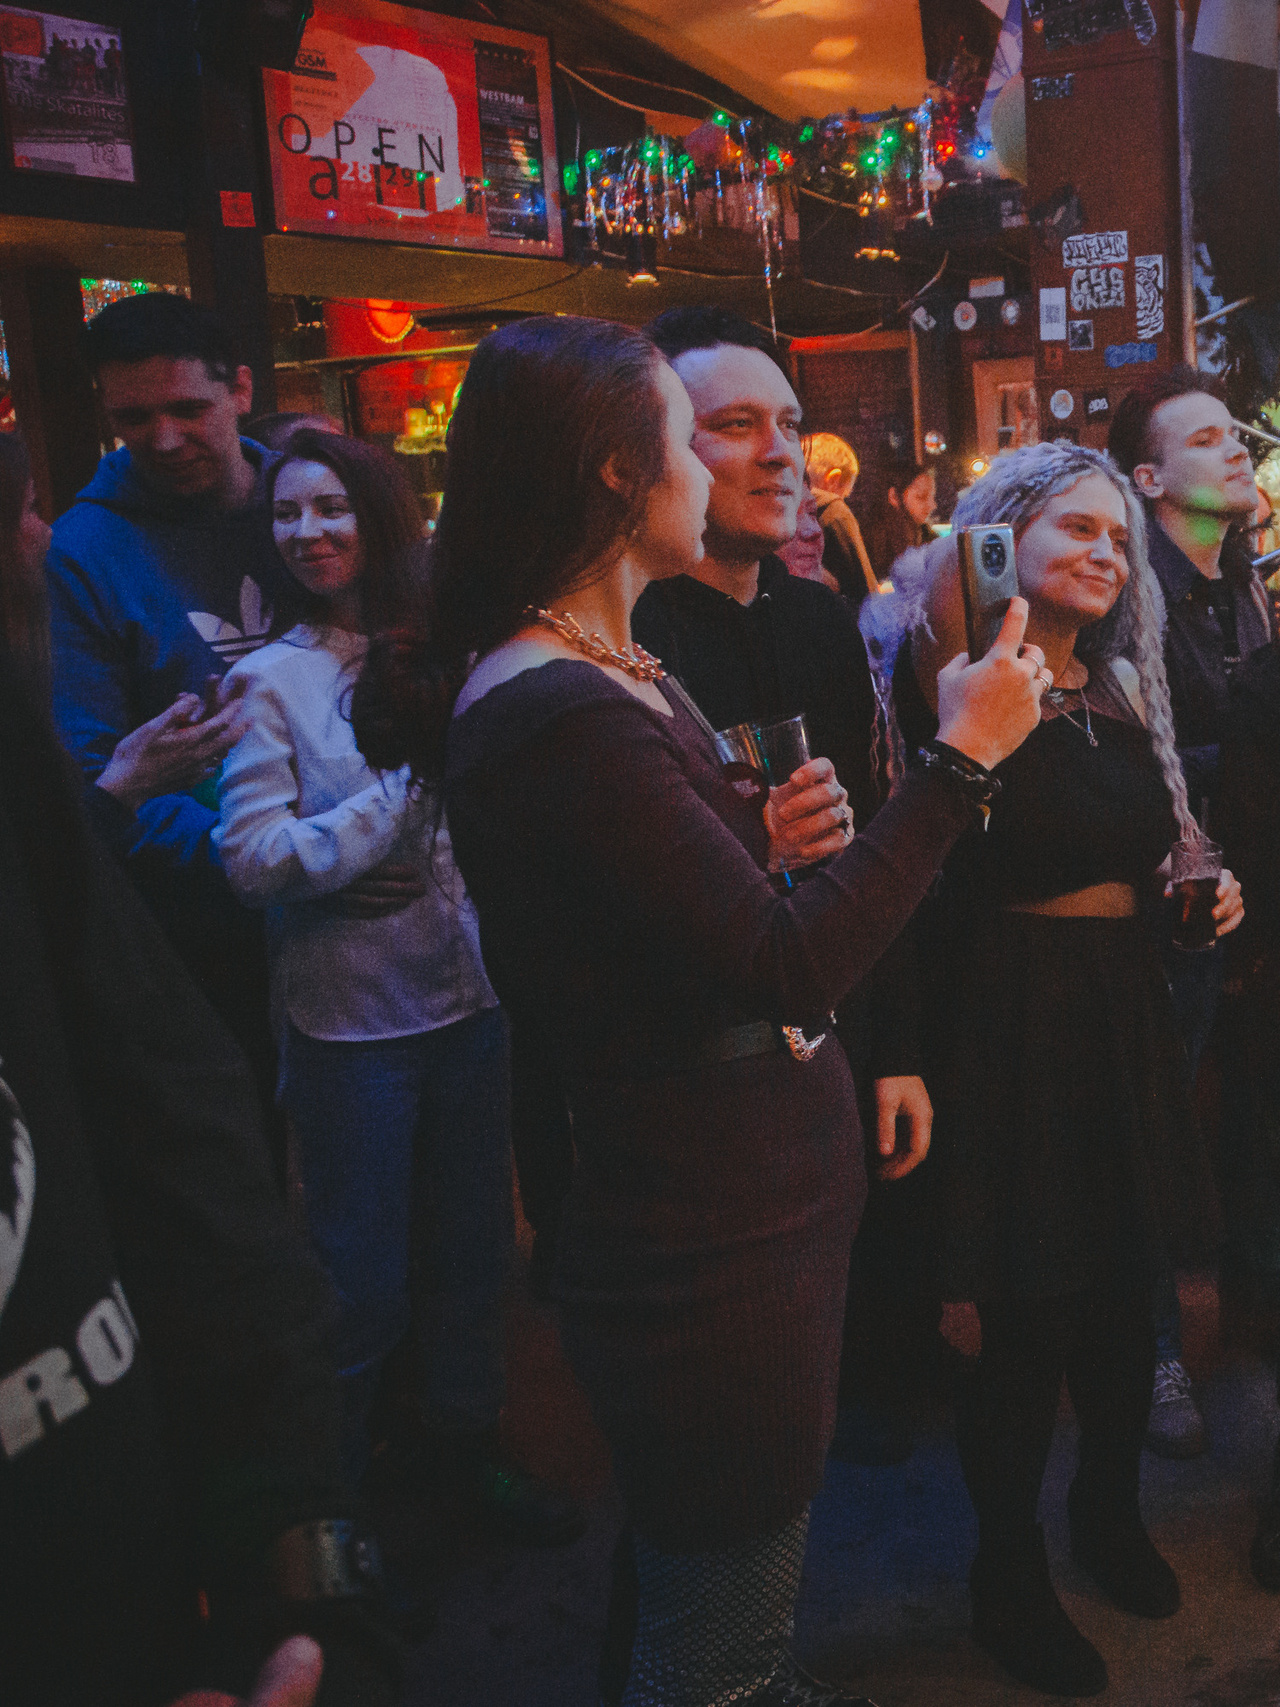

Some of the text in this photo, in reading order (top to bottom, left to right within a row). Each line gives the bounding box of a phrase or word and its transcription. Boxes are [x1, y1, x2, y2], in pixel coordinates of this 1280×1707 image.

[297, 53, 327, 69] GSM
[278, 113, 445, 173] OPEN
[341, 161, 372, 183] 28
[0, 1278, 140, 1460] RO
